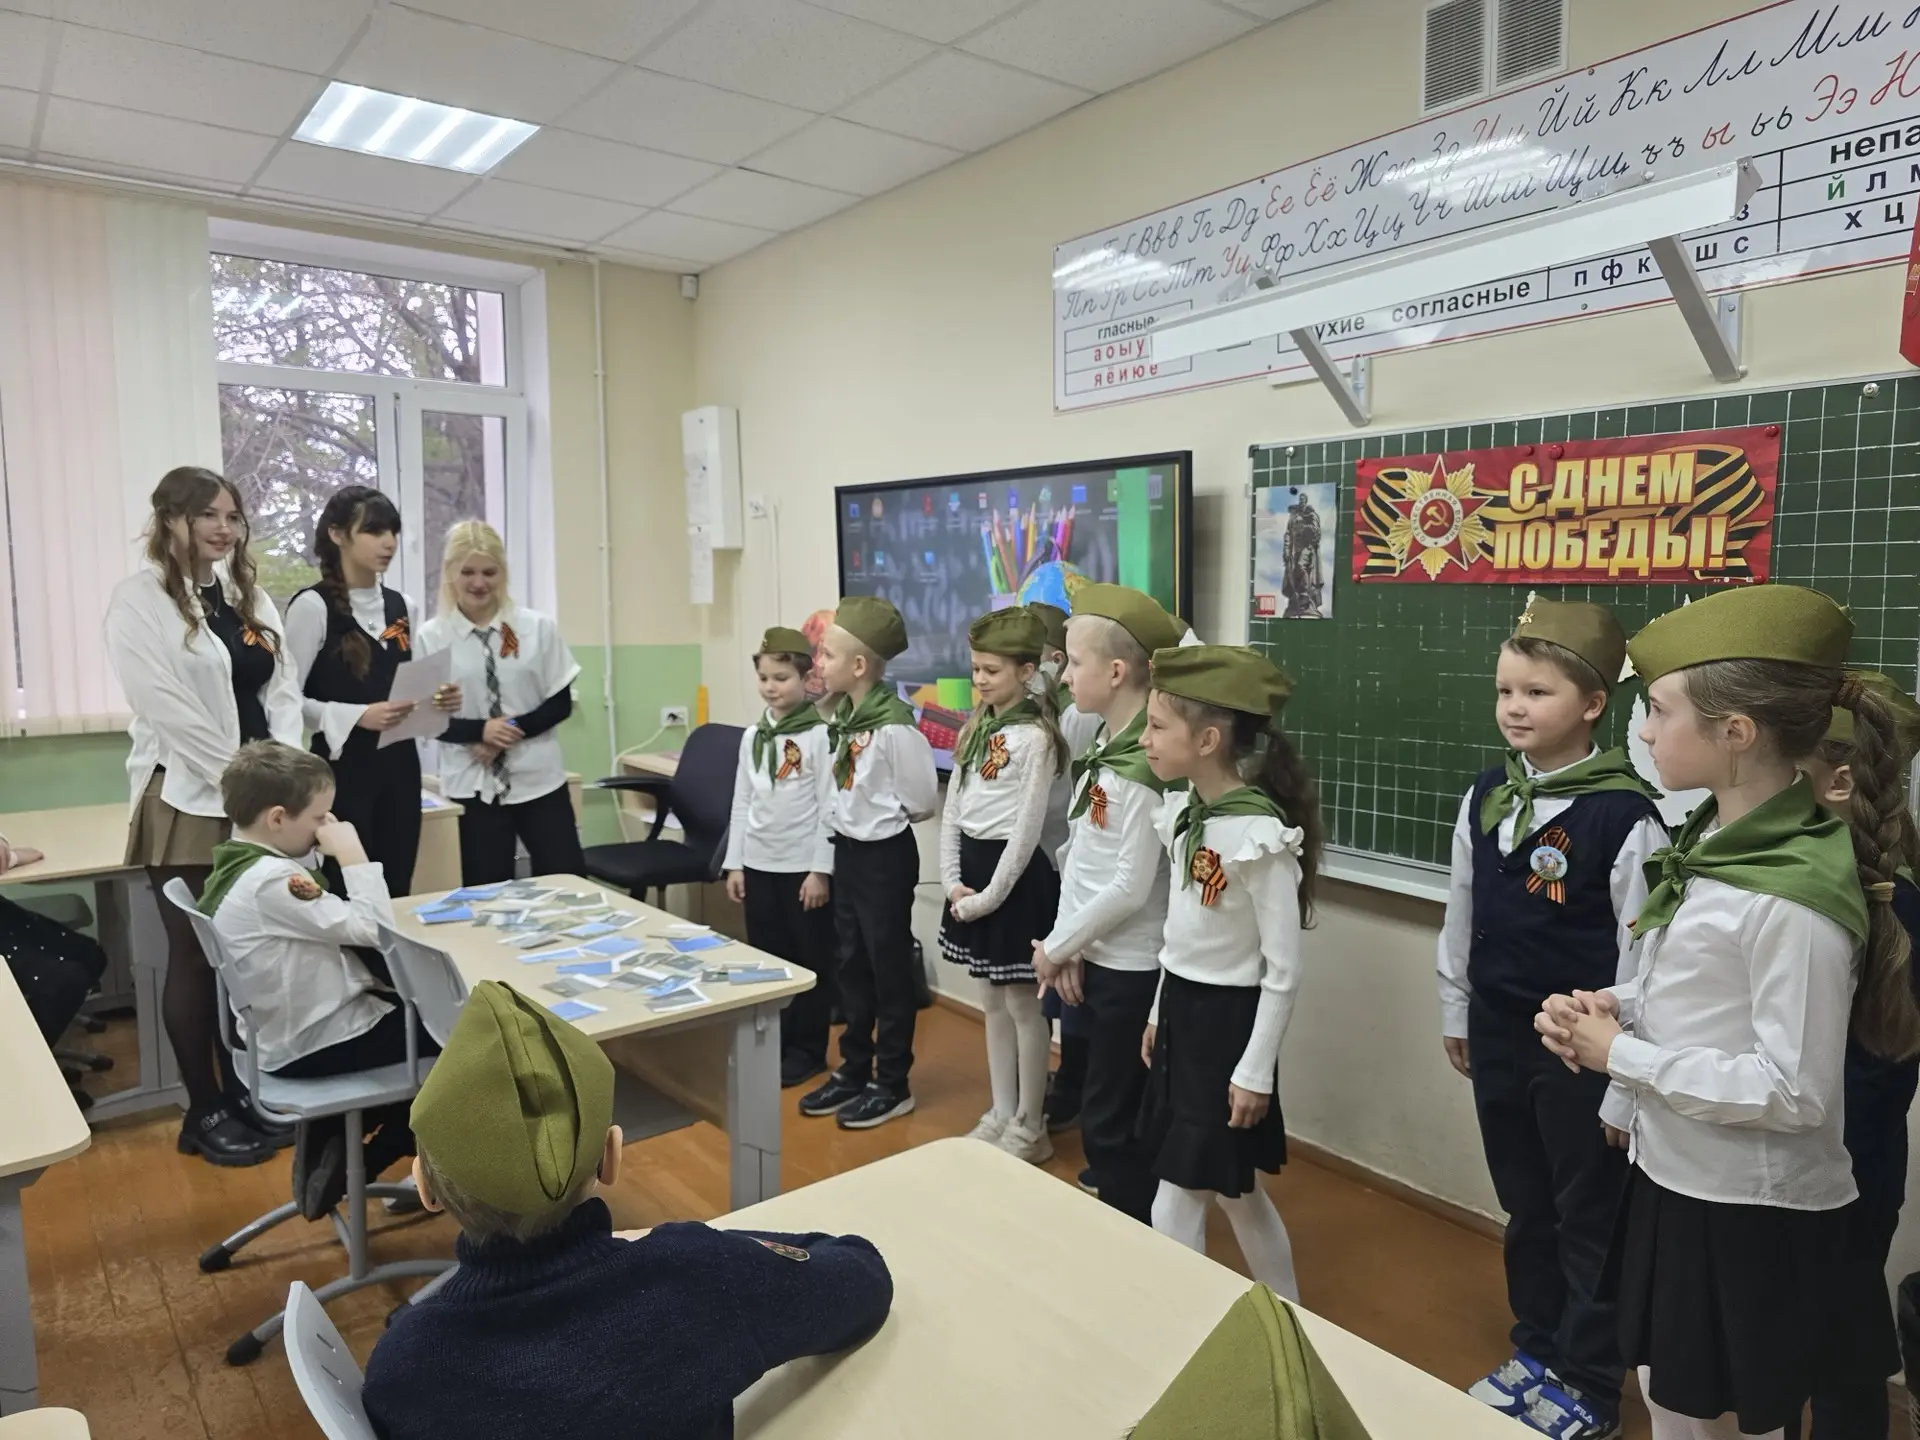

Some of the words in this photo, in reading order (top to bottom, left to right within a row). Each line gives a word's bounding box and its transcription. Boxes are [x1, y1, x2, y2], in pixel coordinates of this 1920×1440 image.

[1702, 122, 1736, 150] ы
[1866, 171, 1887, 192] л
[1601, 258, 1623, 285] ф
[1391, 281, 1531, 324] согласные
[1508, 462, 1540, 513] С
[1545, 450, 1699, 518] ДНЕМ
[1492, 514, 1729, 578] ПОБЕДЫ!
[1573, 1404, 1594, 1424] FILA
